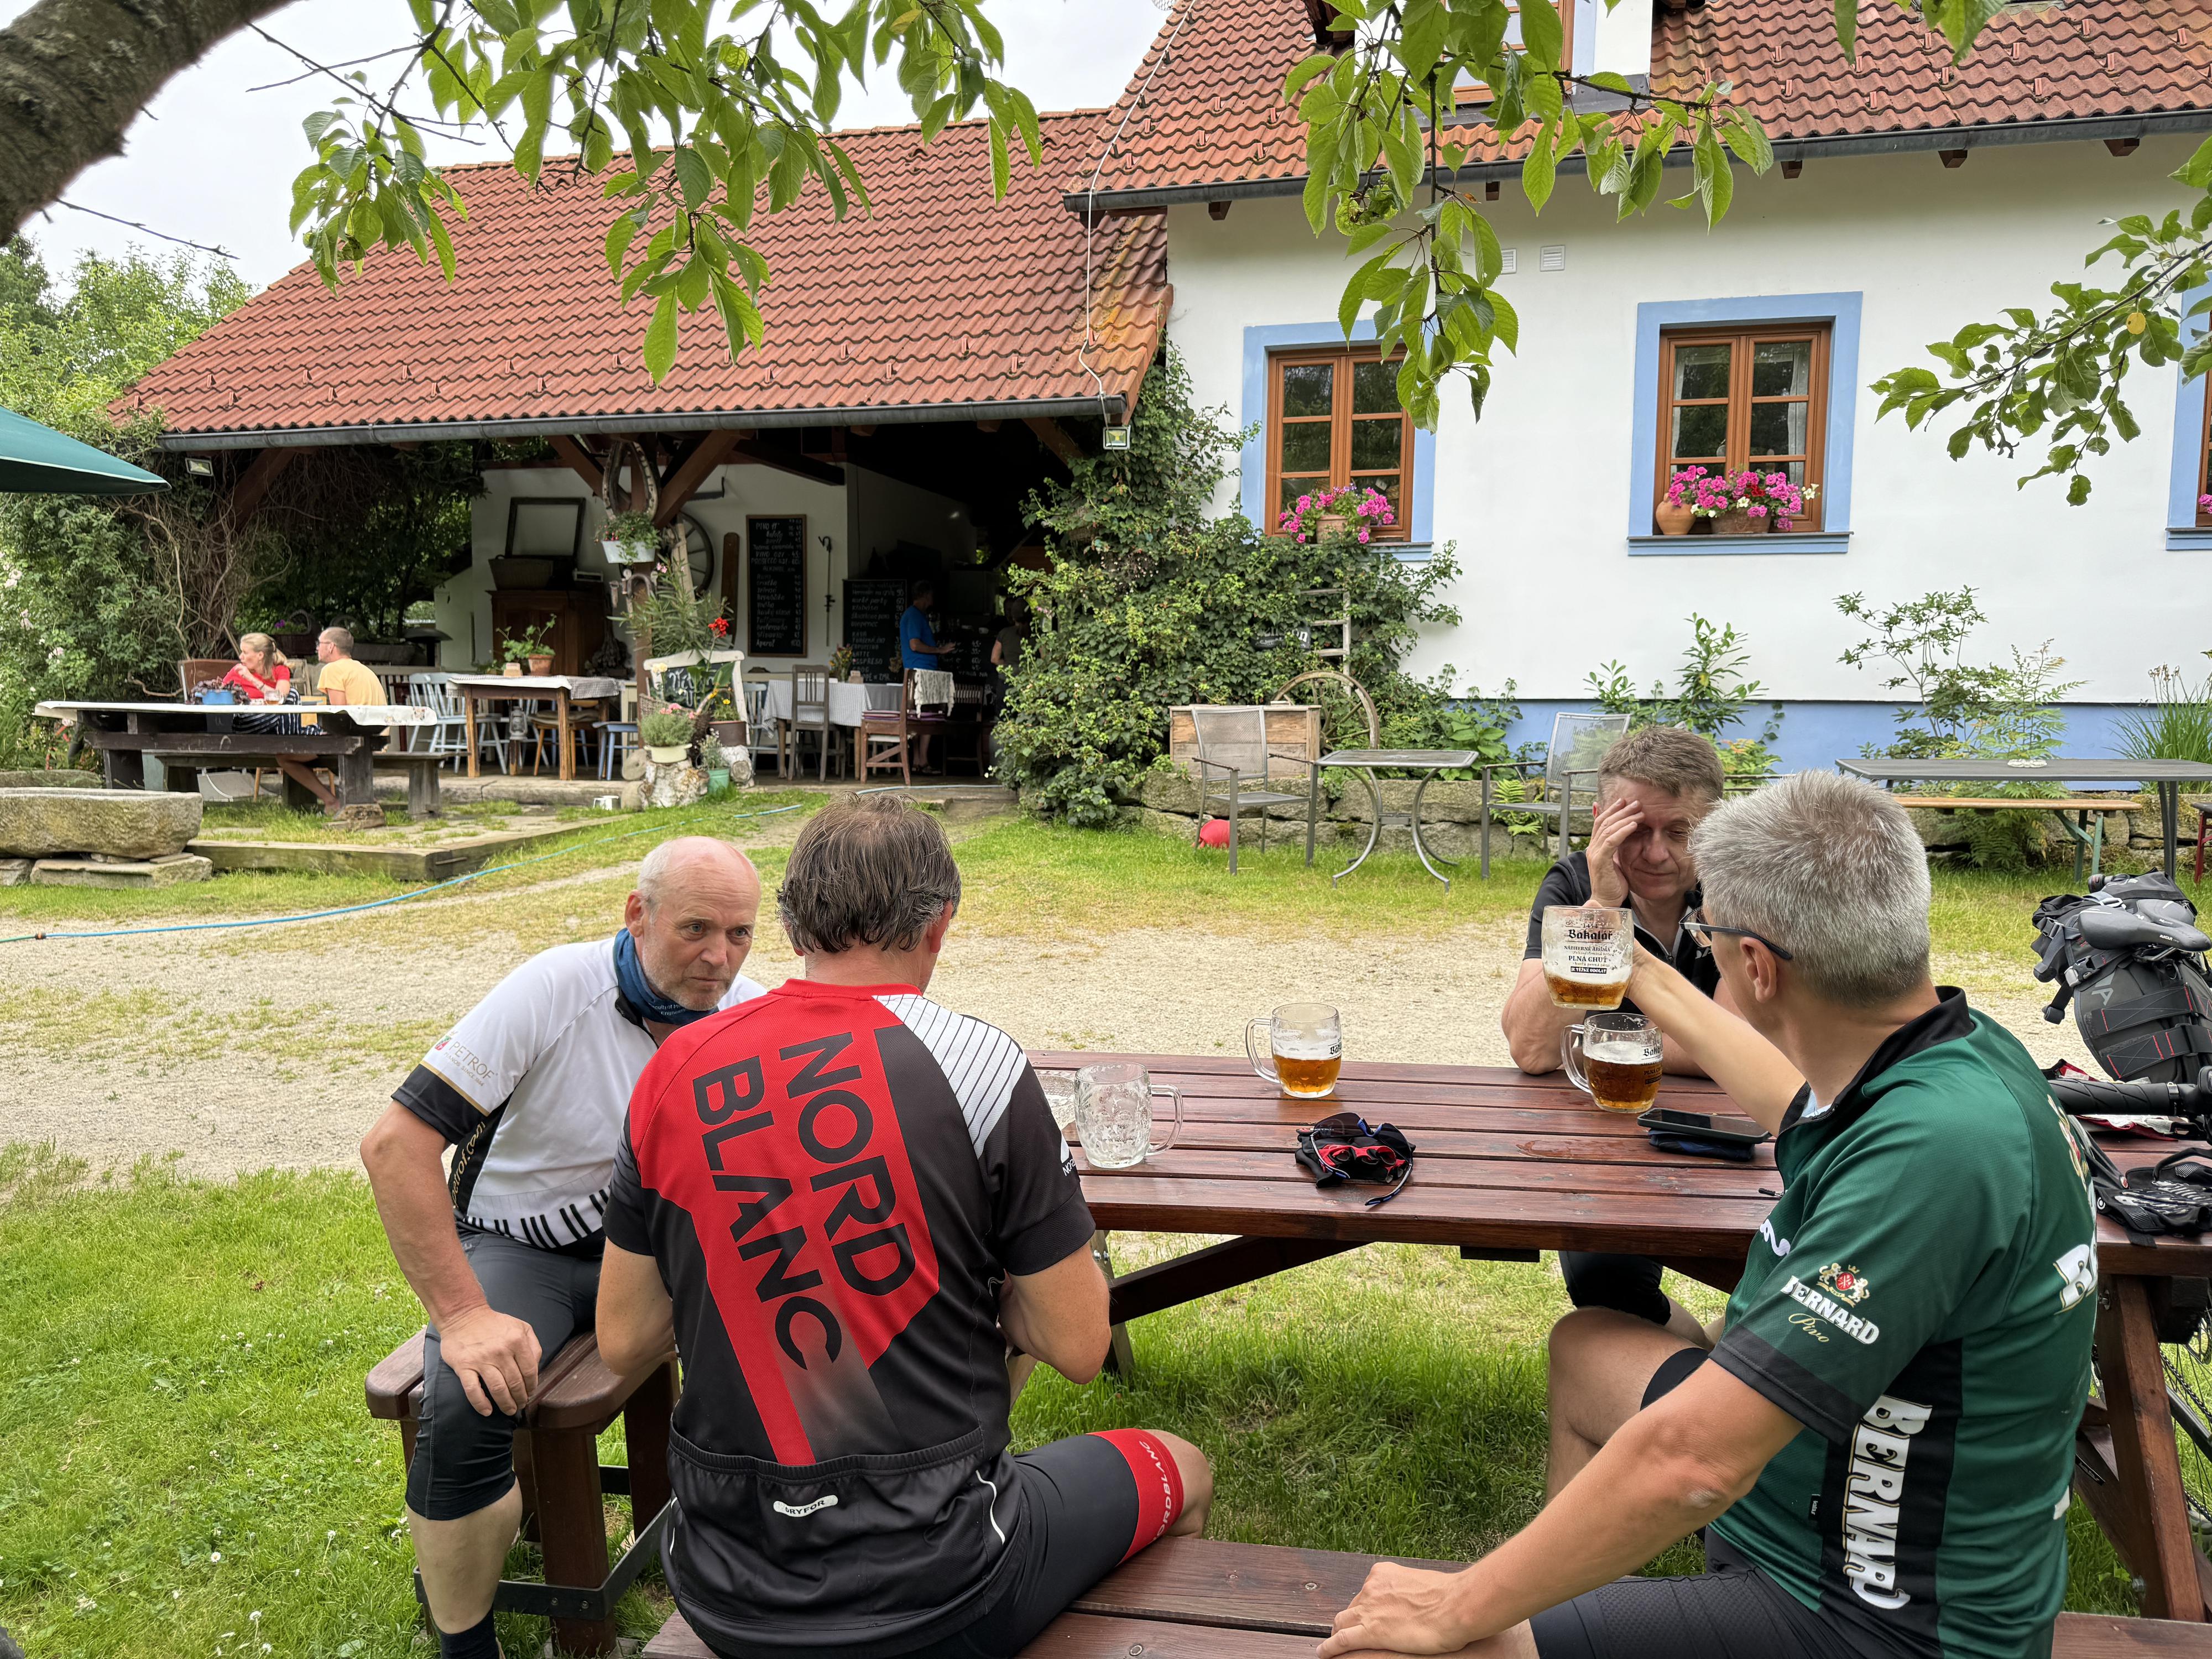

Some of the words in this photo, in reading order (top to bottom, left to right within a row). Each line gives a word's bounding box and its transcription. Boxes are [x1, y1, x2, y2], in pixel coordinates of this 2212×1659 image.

[1568, 929, 1613, 940] Bakalář
[449, 1041, 494, 1078] PETROF
[692, 1056, 842, 1370] BLANC
[779, 1031, 916, 1296] NORD
[1788, 1313, 1829, 1342] Pivo
[1139, 1441, 1171, 1542] ORDBLANC
[1842, 1394, 1933, 1610] BERNARD
